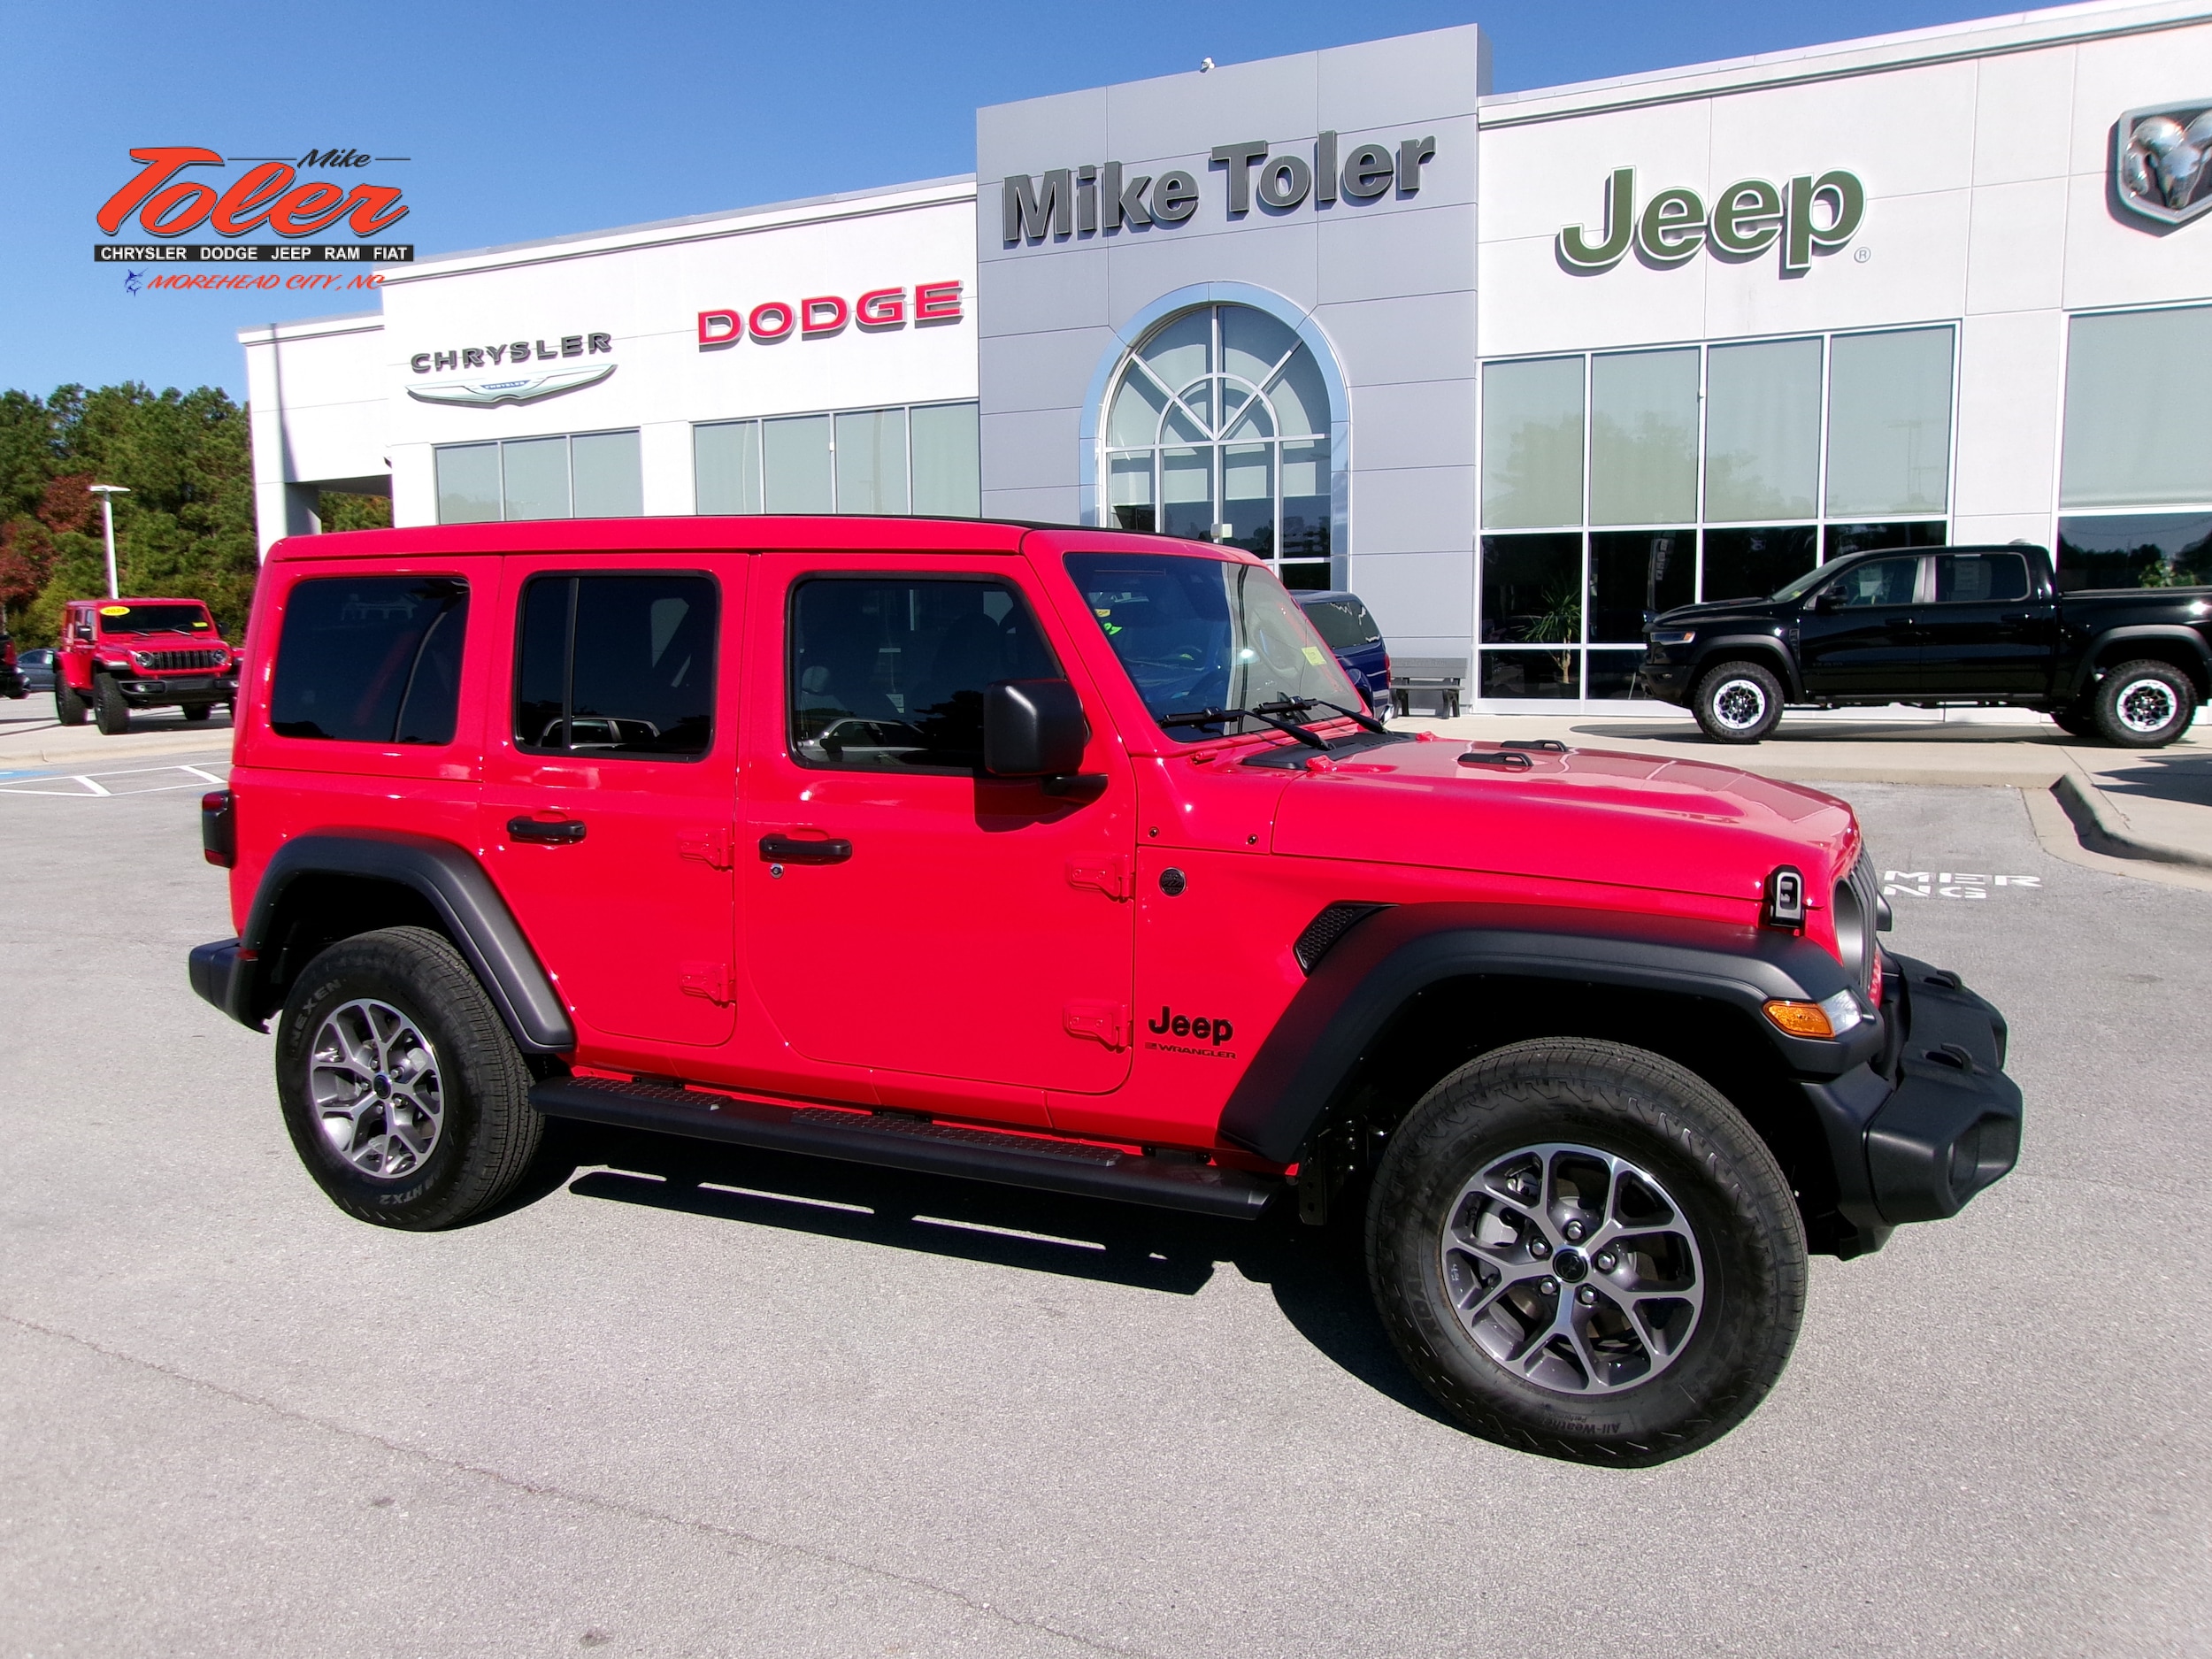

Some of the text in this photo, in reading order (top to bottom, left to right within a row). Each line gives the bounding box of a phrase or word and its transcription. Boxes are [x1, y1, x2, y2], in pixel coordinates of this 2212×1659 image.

[1002, 129, 1436, 242] Mike Toler
[1558, 165, 1868, 271] Jeep
[697, 280, 964, 350] DODGE
[411, 331, 613, 373] CHRYSLER
[289, 979, 342, 1048] NEXEN
[1148, 1005, 1234, 1047] Jeep
[1158, 1042, 1237, 1059] WRANGLER
